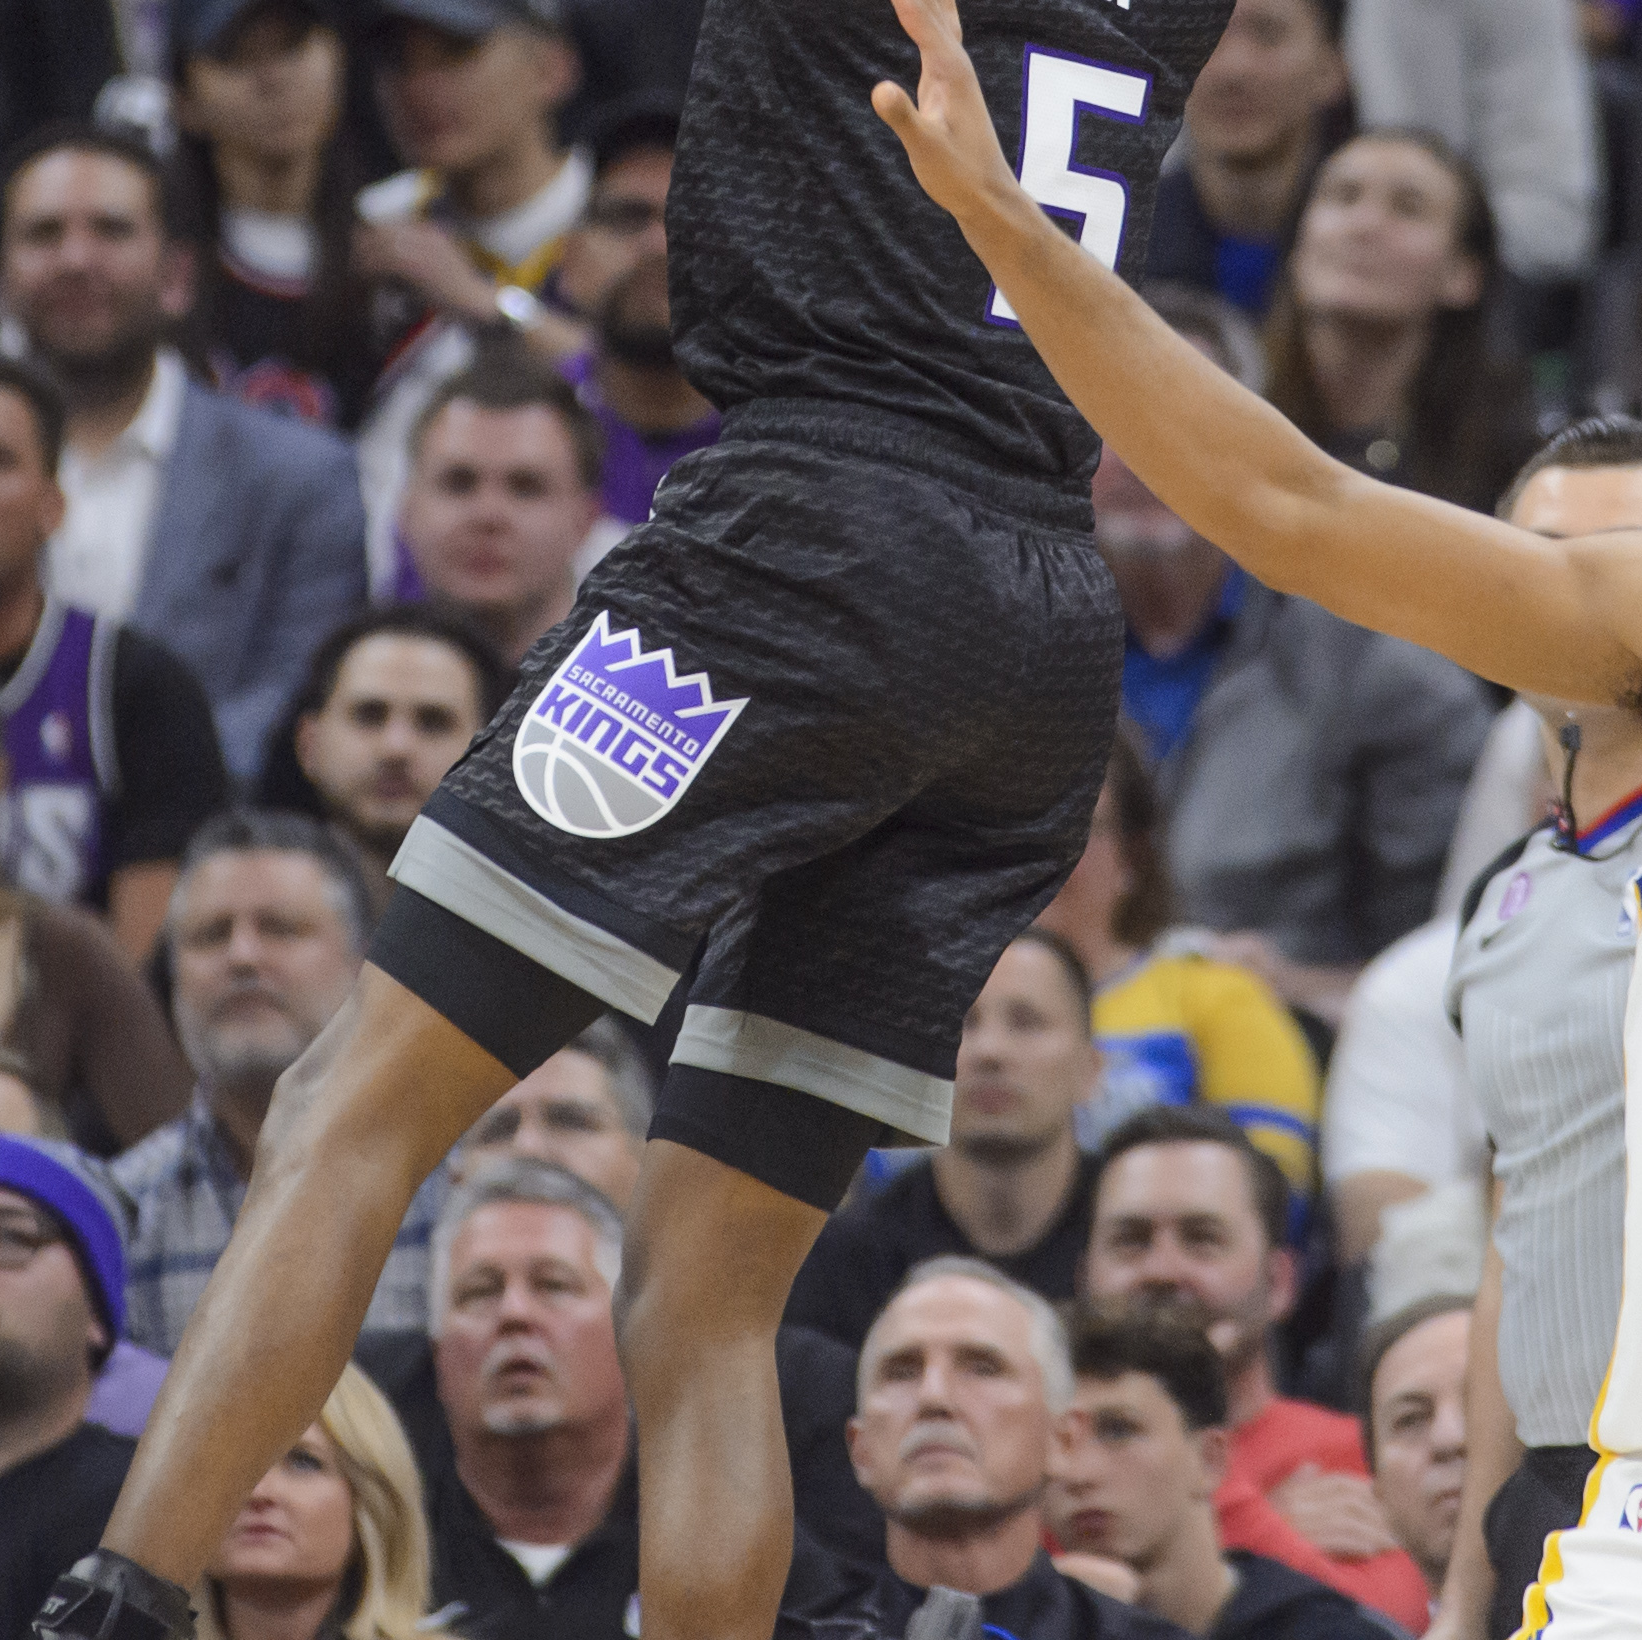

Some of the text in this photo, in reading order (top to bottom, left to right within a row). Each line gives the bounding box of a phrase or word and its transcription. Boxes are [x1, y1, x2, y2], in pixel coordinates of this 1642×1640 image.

[984, 42, 1154, 328] 5
[534, 682, 690, 800] KINGS
[566, 664, 701, 758] SACRAMENTO
